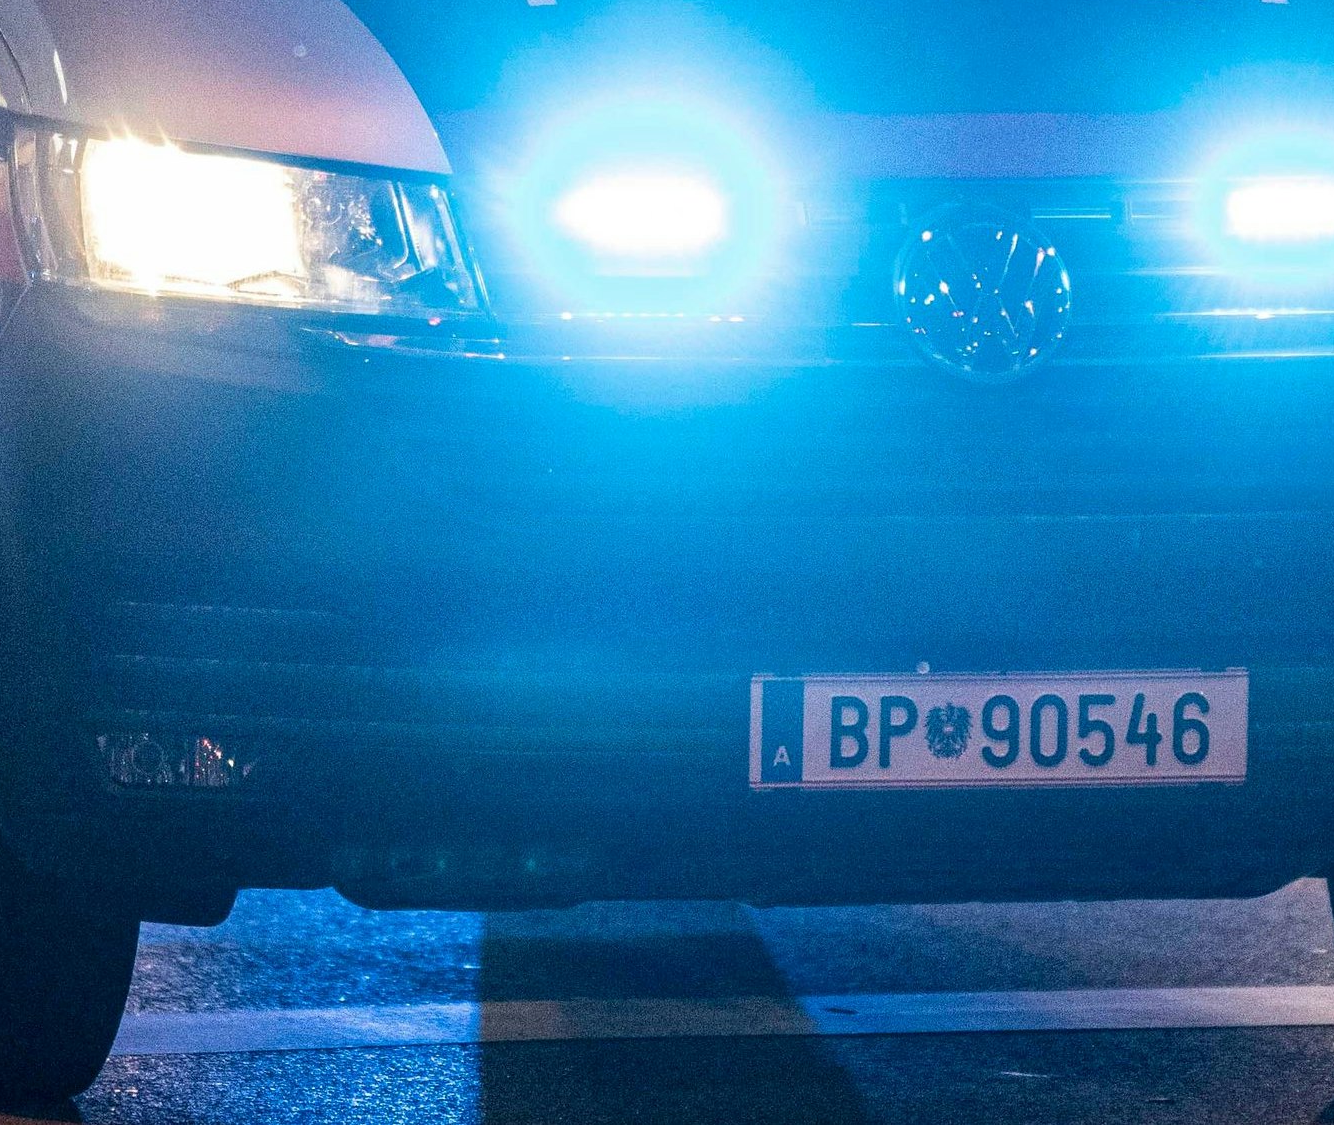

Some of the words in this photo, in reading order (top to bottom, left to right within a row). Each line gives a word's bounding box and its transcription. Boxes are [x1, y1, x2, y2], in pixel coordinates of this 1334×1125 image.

[772, 744, 792, 768] A
[829, 694, 919, 770] BP
[981, 691, 1211, 769] 90546
